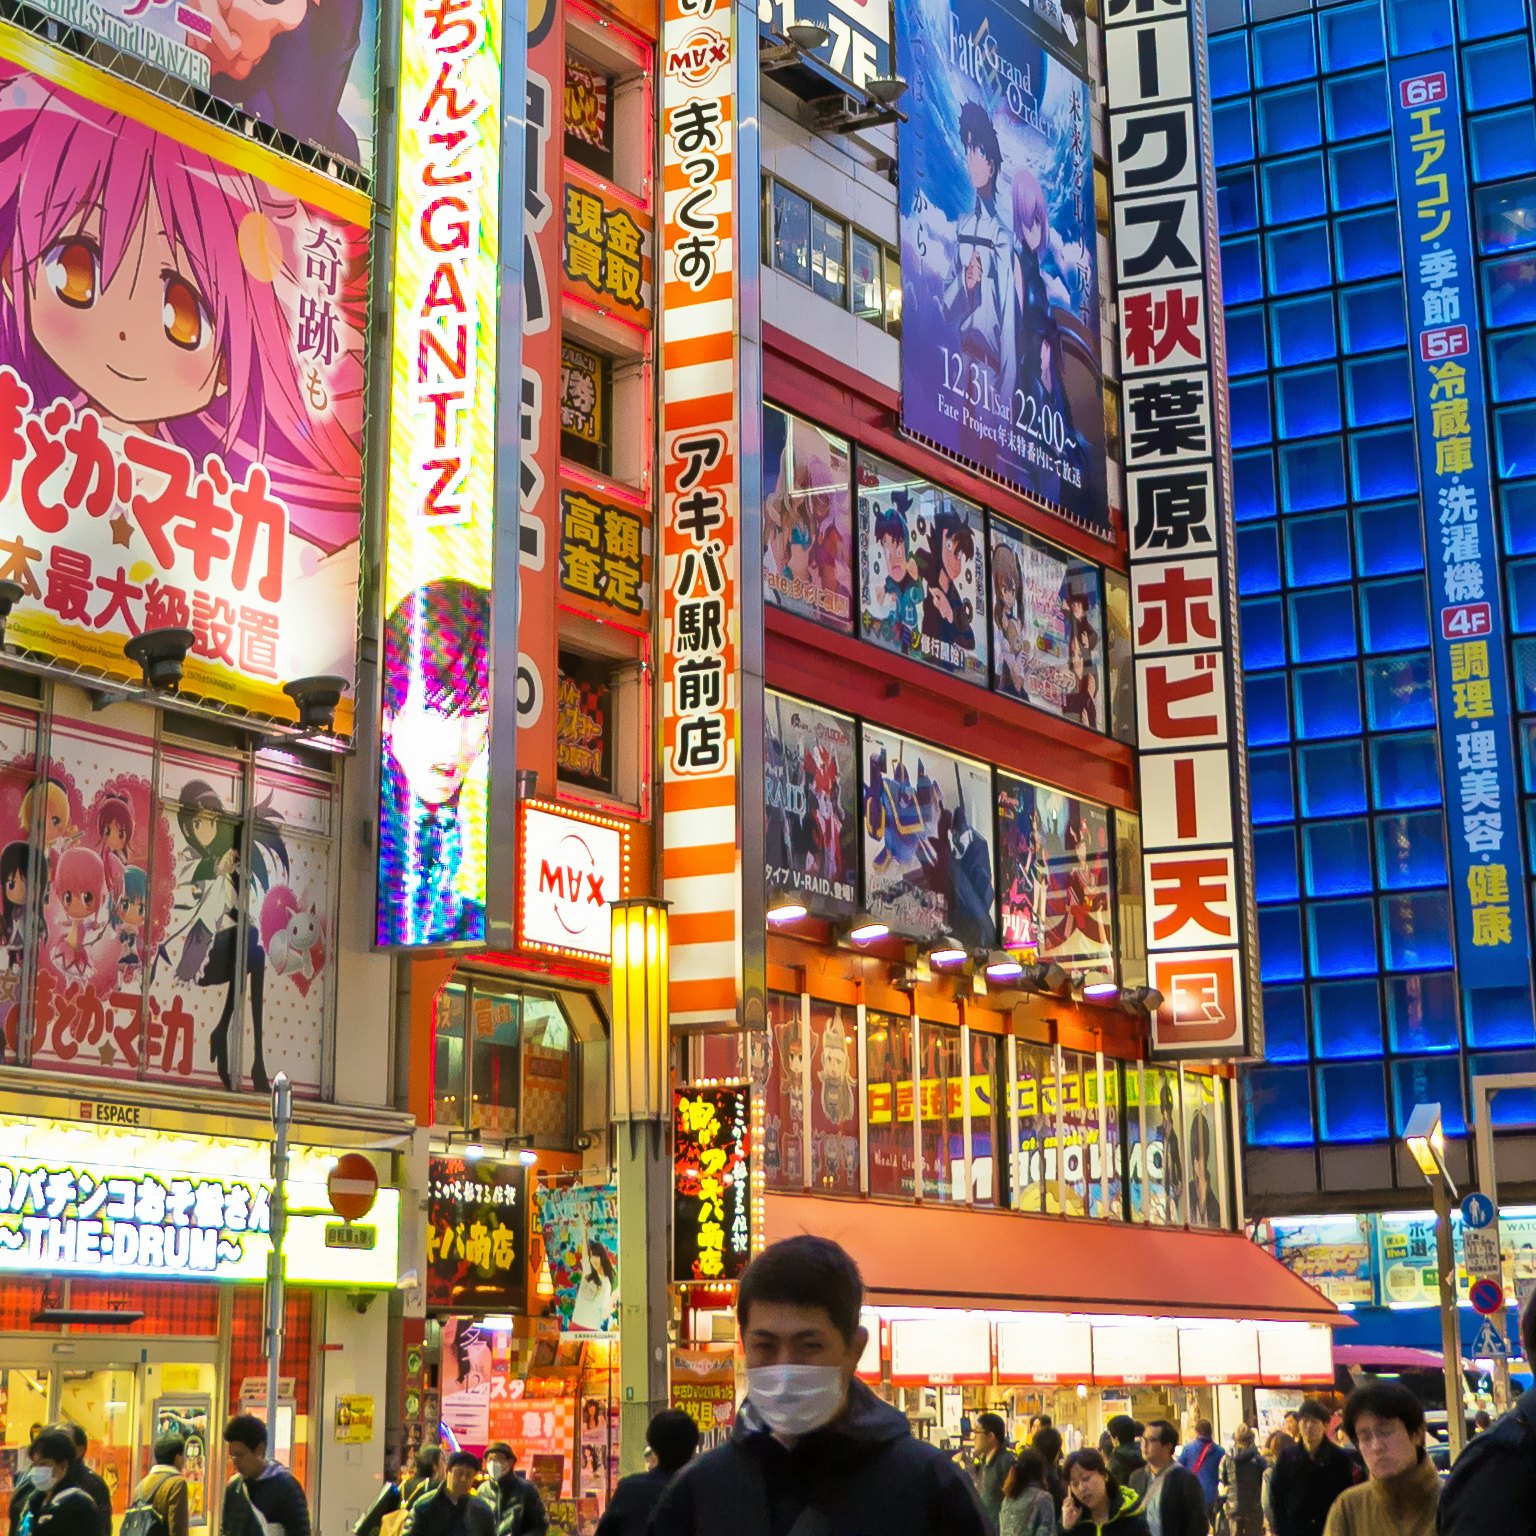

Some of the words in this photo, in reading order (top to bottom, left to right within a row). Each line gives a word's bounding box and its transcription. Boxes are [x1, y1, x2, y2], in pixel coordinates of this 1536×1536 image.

[144, 28, 211, 92] PANZER
[948, 10, 985, 86] Fate
[1407, 76, 1443, 103] 6F
[566, 186, 643, 258] 現金
[670, 100, 722, 291] まっくす
[1409, 109, 1461, 326] エアコン・季節
[566, 238, 643, 309] 買取
[296, 224, 347, 413] 奇跡も
[1425, 330, 1465, 358] 5F
[938, 392, 960, 425] Fate
[941, 347, 992, 414] 12.31
[1428, 364, 1486, 602] 冷蔵庫・洗濯機
[563, 493, 643, 564] 高額
[562, 544, 642, 613] 査定
[673, 431, 725, 769] アキバ駅前店
[1446, 609, 1487, 636] 4F
[1449, 642, 1513, 949] 調理・理美容・健康
[96, 1104, 141, 1124] ESPACE
